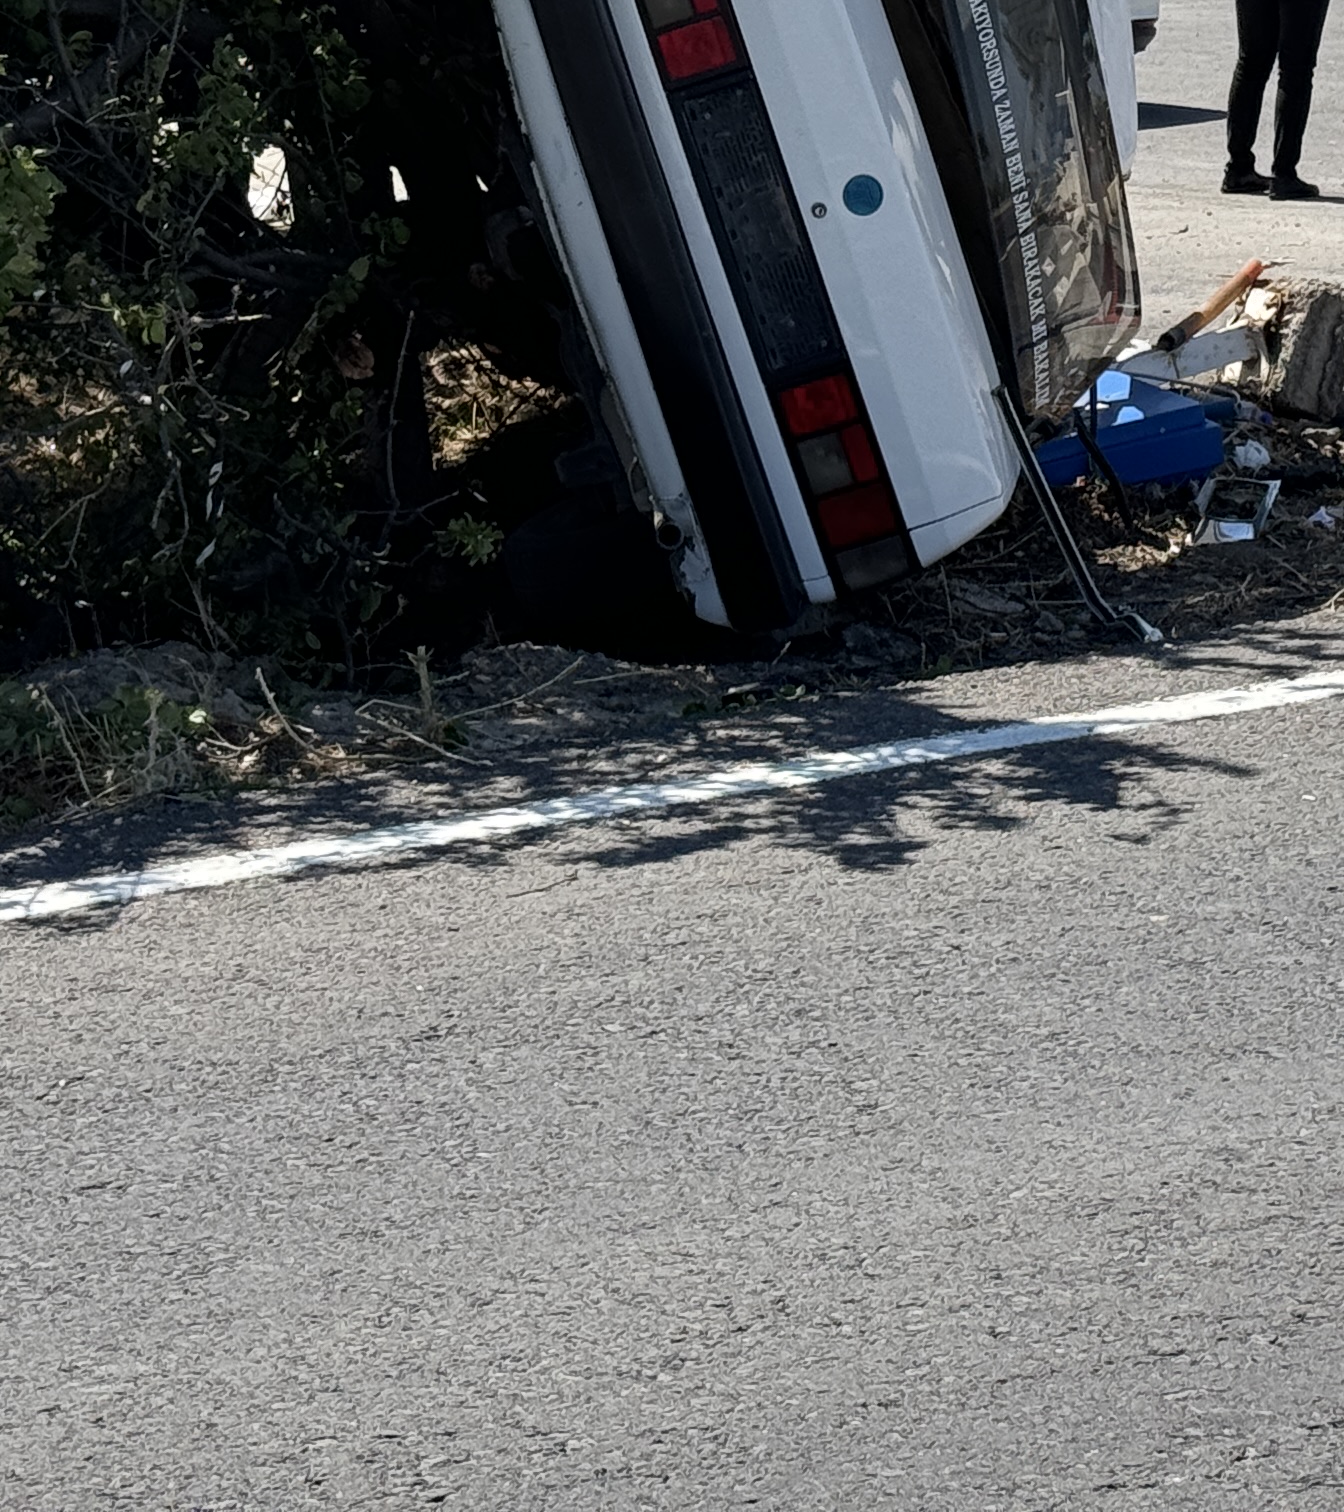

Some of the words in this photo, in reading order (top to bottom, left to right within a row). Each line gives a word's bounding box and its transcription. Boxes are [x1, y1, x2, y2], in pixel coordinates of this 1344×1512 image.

[994, 100, 1019, 154] ZAMAN
[1013, 191, 1033, 234] SANA
[1020, 233, 1047, 322] BIRAKACAK
[1032, 318, 1047, 342] MI
